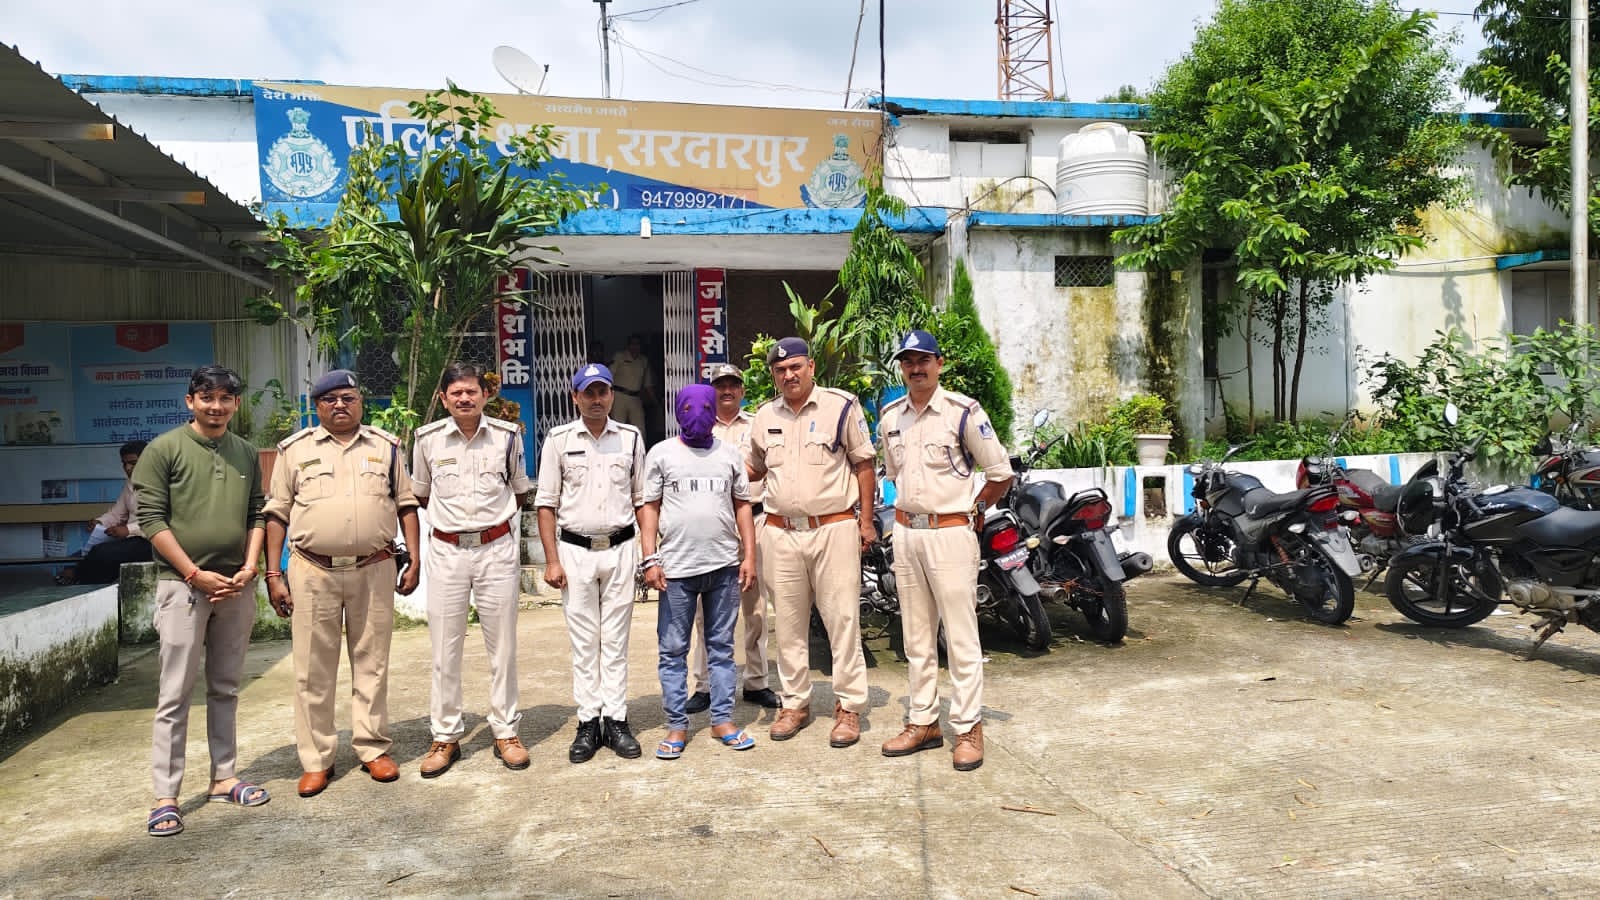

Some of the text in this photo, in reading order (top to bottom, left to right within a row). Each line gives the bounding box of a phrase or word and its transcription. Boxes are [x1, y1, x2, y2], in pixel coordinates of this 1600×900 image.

[262, 88, 286, 100] देश
[616, 128, 809, 187] सरदारपुर
[641, 190, 747, 210] 9479992171
